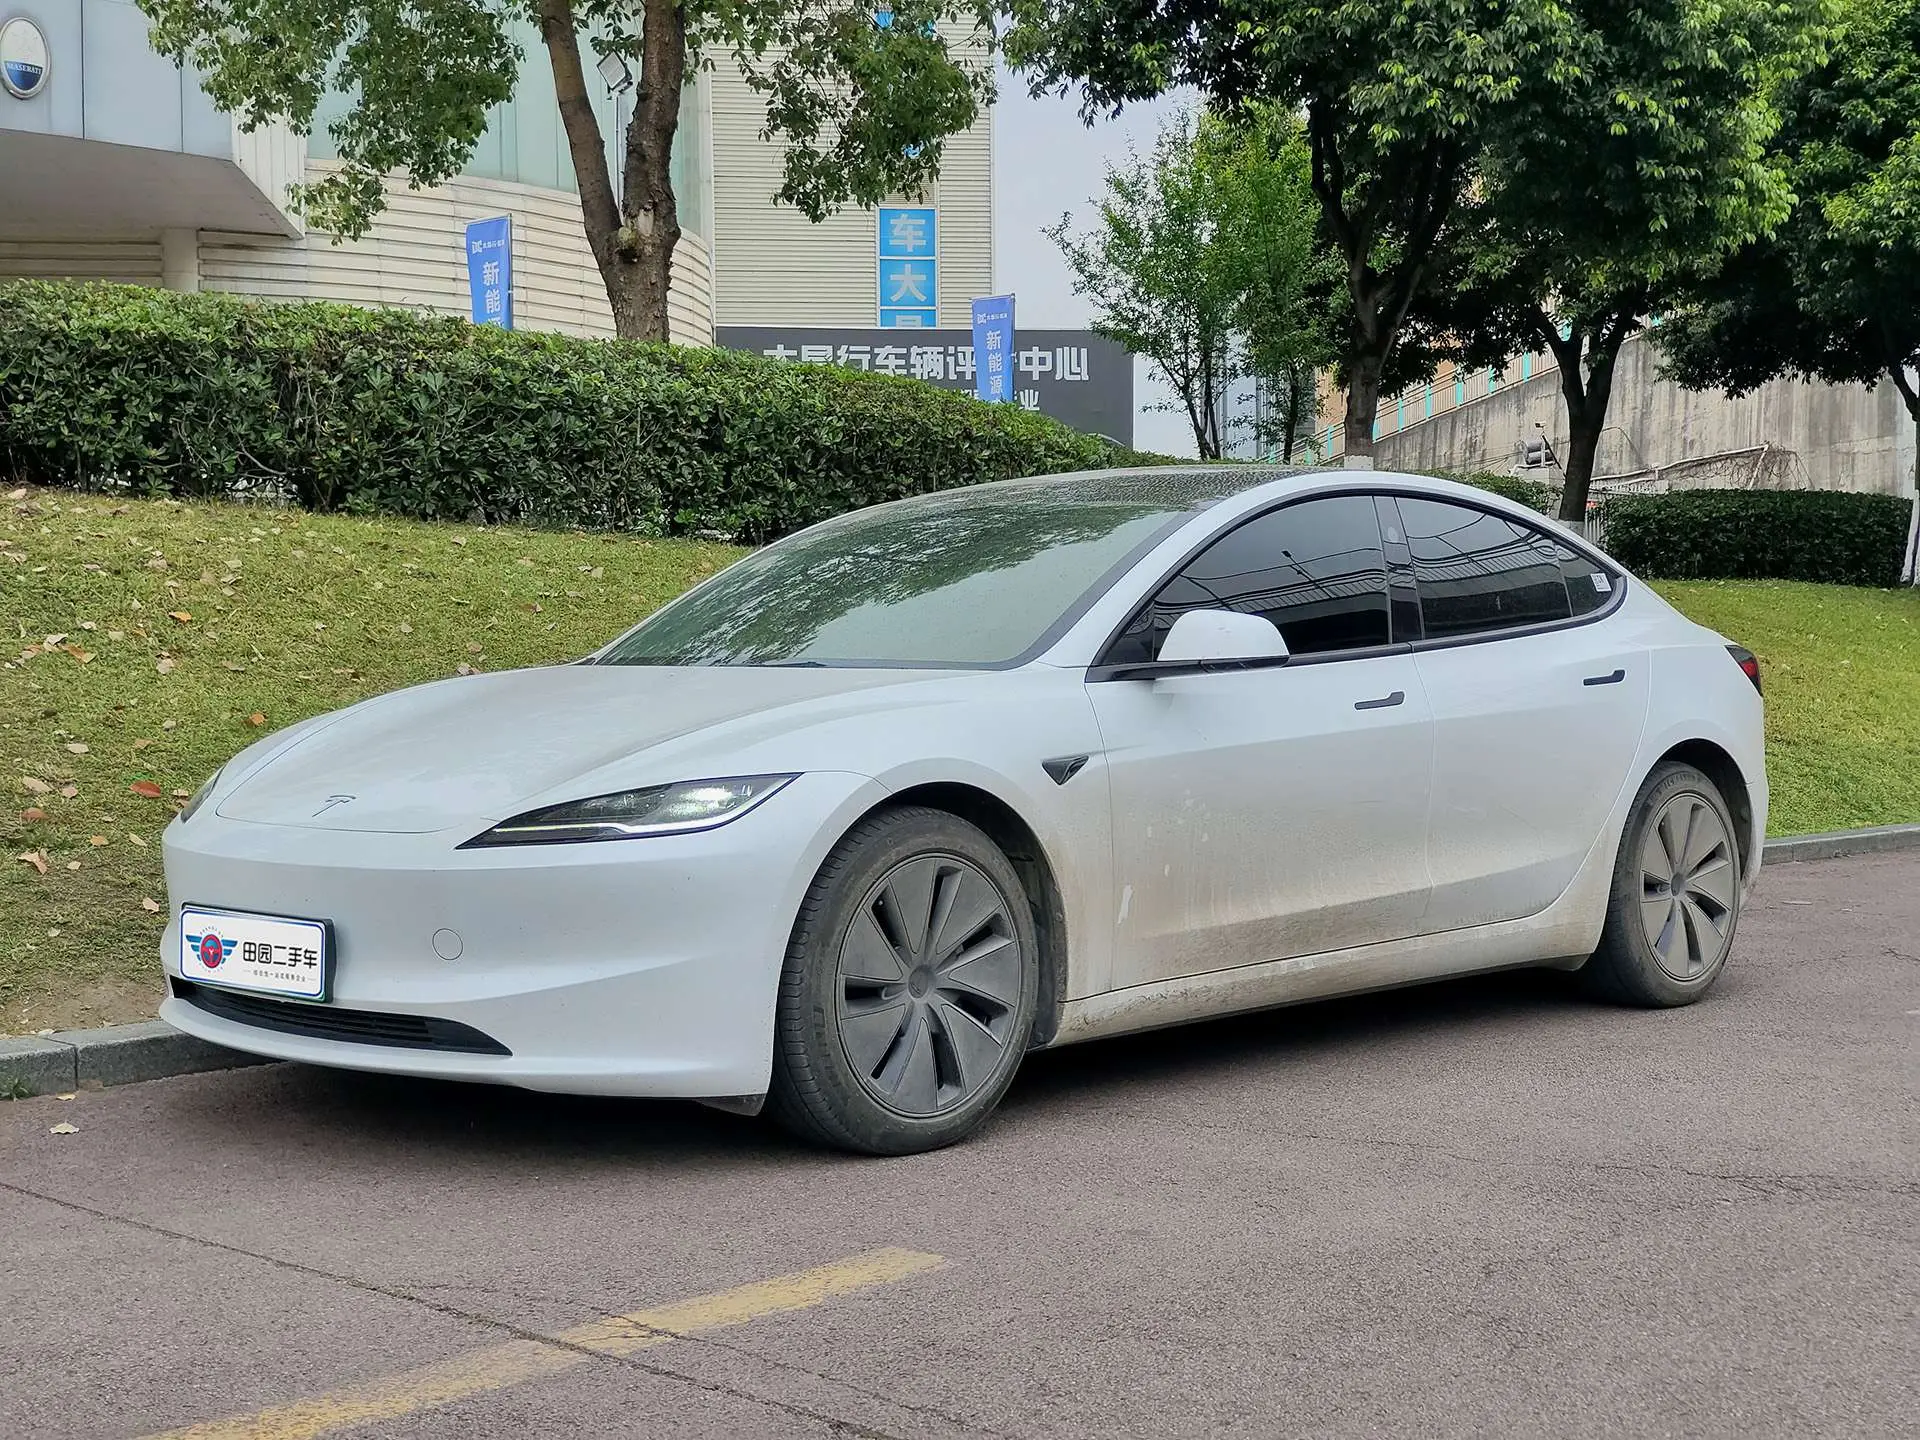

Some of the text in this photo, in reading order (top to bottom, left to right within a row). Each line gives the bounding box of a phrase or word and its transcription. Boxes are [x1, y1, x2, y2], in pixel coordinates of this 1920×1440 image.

[242, 942, 318, 969] 田园二手车
